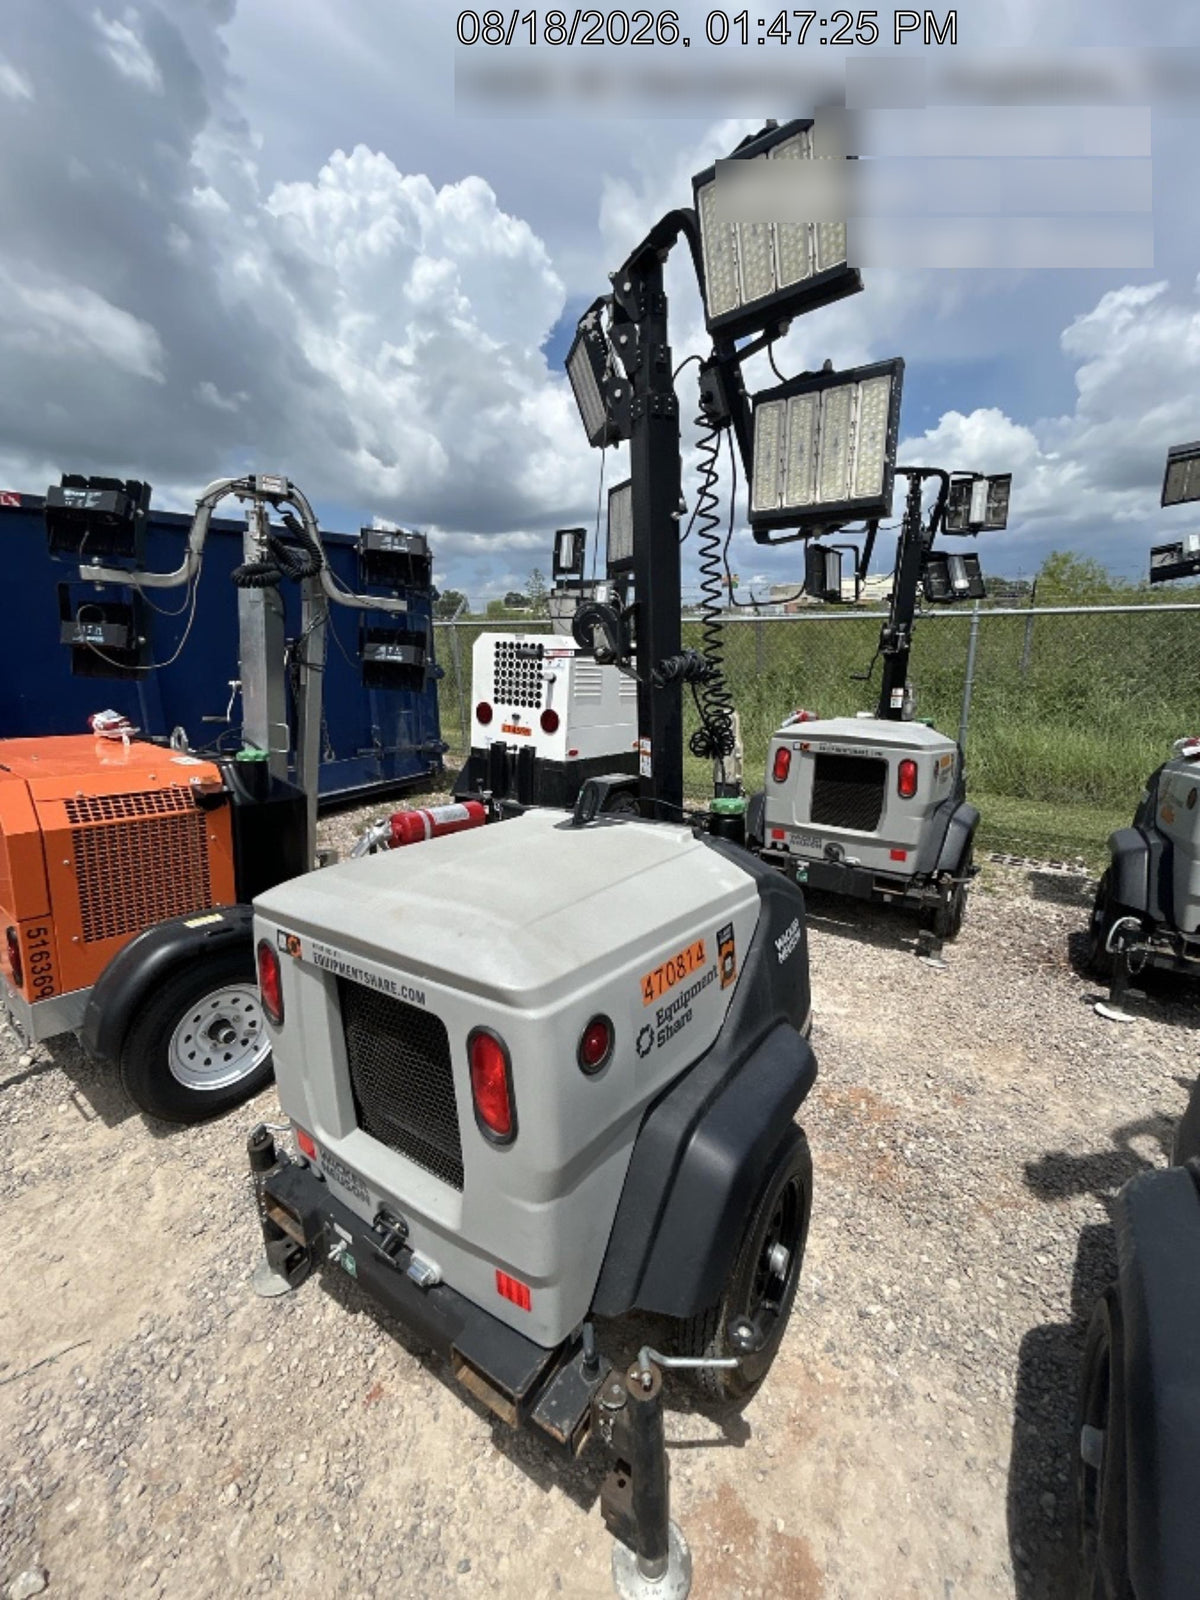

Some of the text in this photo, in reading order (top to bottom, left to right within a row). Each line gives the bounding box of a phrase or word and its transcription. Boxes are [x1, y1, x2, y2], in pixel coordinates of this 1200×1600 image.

[26, 927, 55, 1000] 516369
[313, 952, 426, 1006] EQUIPMENTSHARE.COM
[643, 942, 705, 1001] 470814
[655, 964, 719, 1028] Equipment
[657, 1008, 693, 1049] Share
